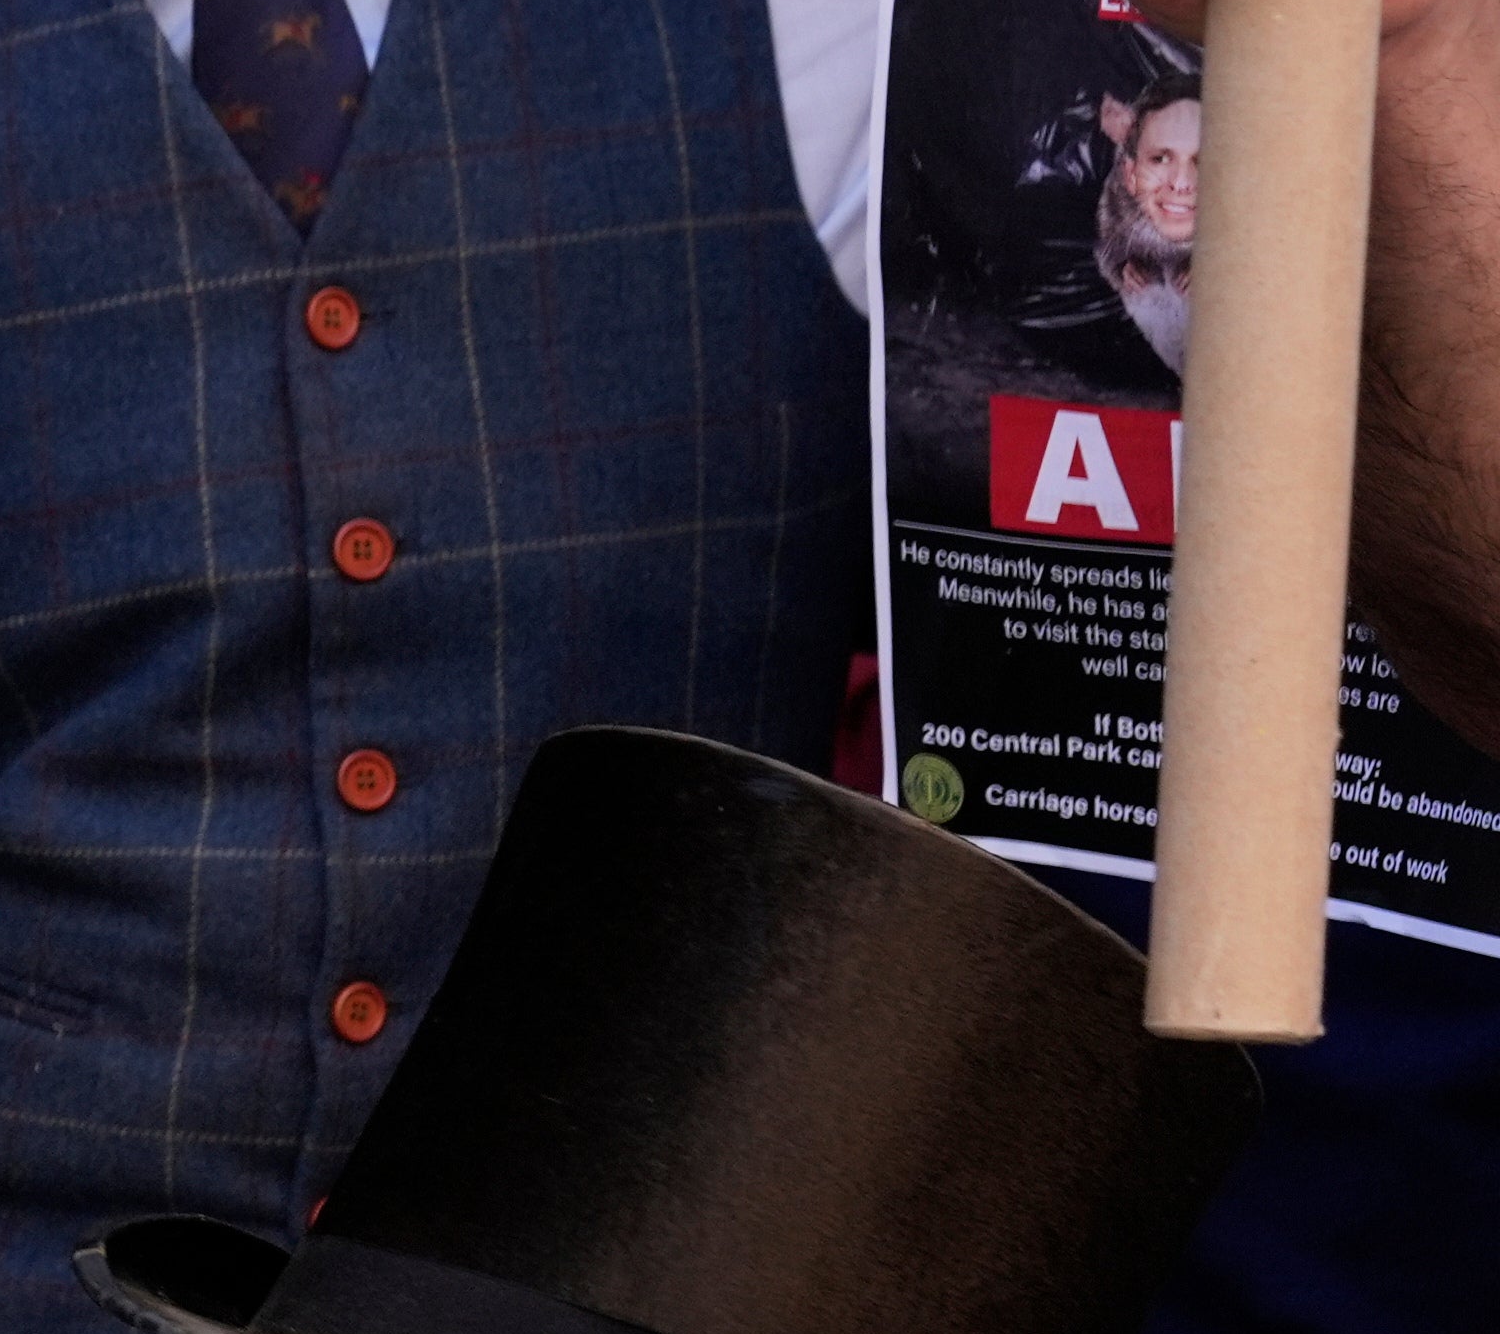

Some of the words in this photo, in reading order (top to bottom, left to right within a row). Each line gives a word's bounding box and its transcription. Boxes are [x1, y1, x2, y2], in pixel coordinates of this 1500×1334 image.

[1025, 409, 1139, 532] A
[901, 539, 930, 565] He
[935, 549, 1044, 585] constantly
[1050, 565, 1143, 589] spreads
[1149, 568, 1170, 592] lie
[939, 576, 1061, 615] Meanwhile,
[1068, 591, 1097, 615] he
[1104, 594, 1145, 619] has
[1003, 617, 1027, 639] to
[1032, 619, 1079, 644] visit
[1085, 623, 1123, 647] the
[1081, 655, 1128, 678] well
[1366, 689, 1400, 714] are
[1094, 713, 1110, 736] If
[922, 723, 965, 748] 200
[971, 729, 1060, 756] Central
[1067, 737, 1121, 764] Park
[985, 784, 1088, 819] Carriage
[1378, 783, 1403, 811] be
[1345, 844, 1379, 870] out
[1382, 850, 1405, 874] of
[1406, 855, 1450, 884] work
